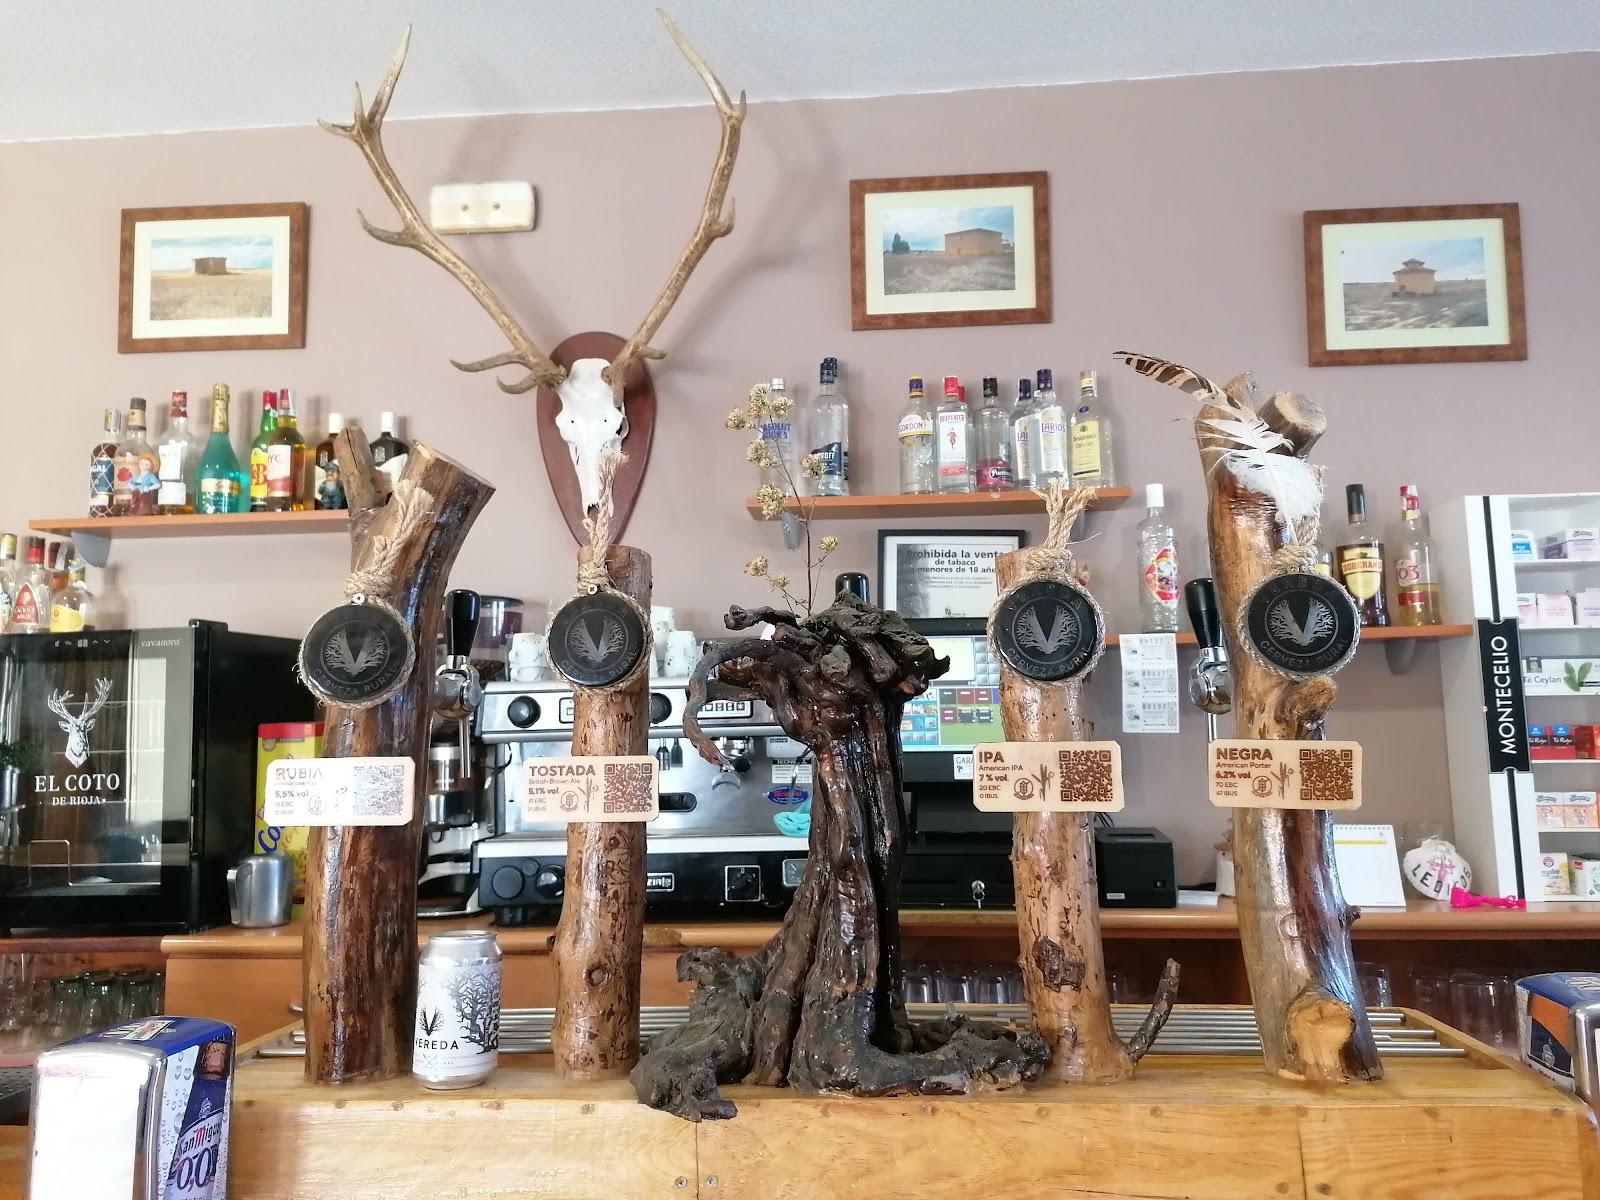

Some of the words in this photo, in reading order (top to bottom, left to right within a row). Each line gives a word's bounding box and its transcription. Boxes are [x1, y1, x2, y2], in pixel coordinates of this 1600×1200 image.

[1042, 422, 1066, 433] LARIOS
[906, 549, 957, 558] Prohibida
[962, 550, 970, 558] la
[1260, 640, 1312, 668] CERVEZA
[1534, 676, 1561, 684] Ceylan
[1490, 636, 1517, 754] MONTECELIO
[979, 752, 1004, 763] IPA
[1216, 748, 1273, 760] NEGRA
[276, 768, 322, 779] RUBIA
[529, 764, 596, 776] TOSTADA
[34, 775, 59, 792] EL
[65, 773, 120, 791] COTO
[52, 797, 66, 806] DE
[70, 796, 101, 806] RIOJA
